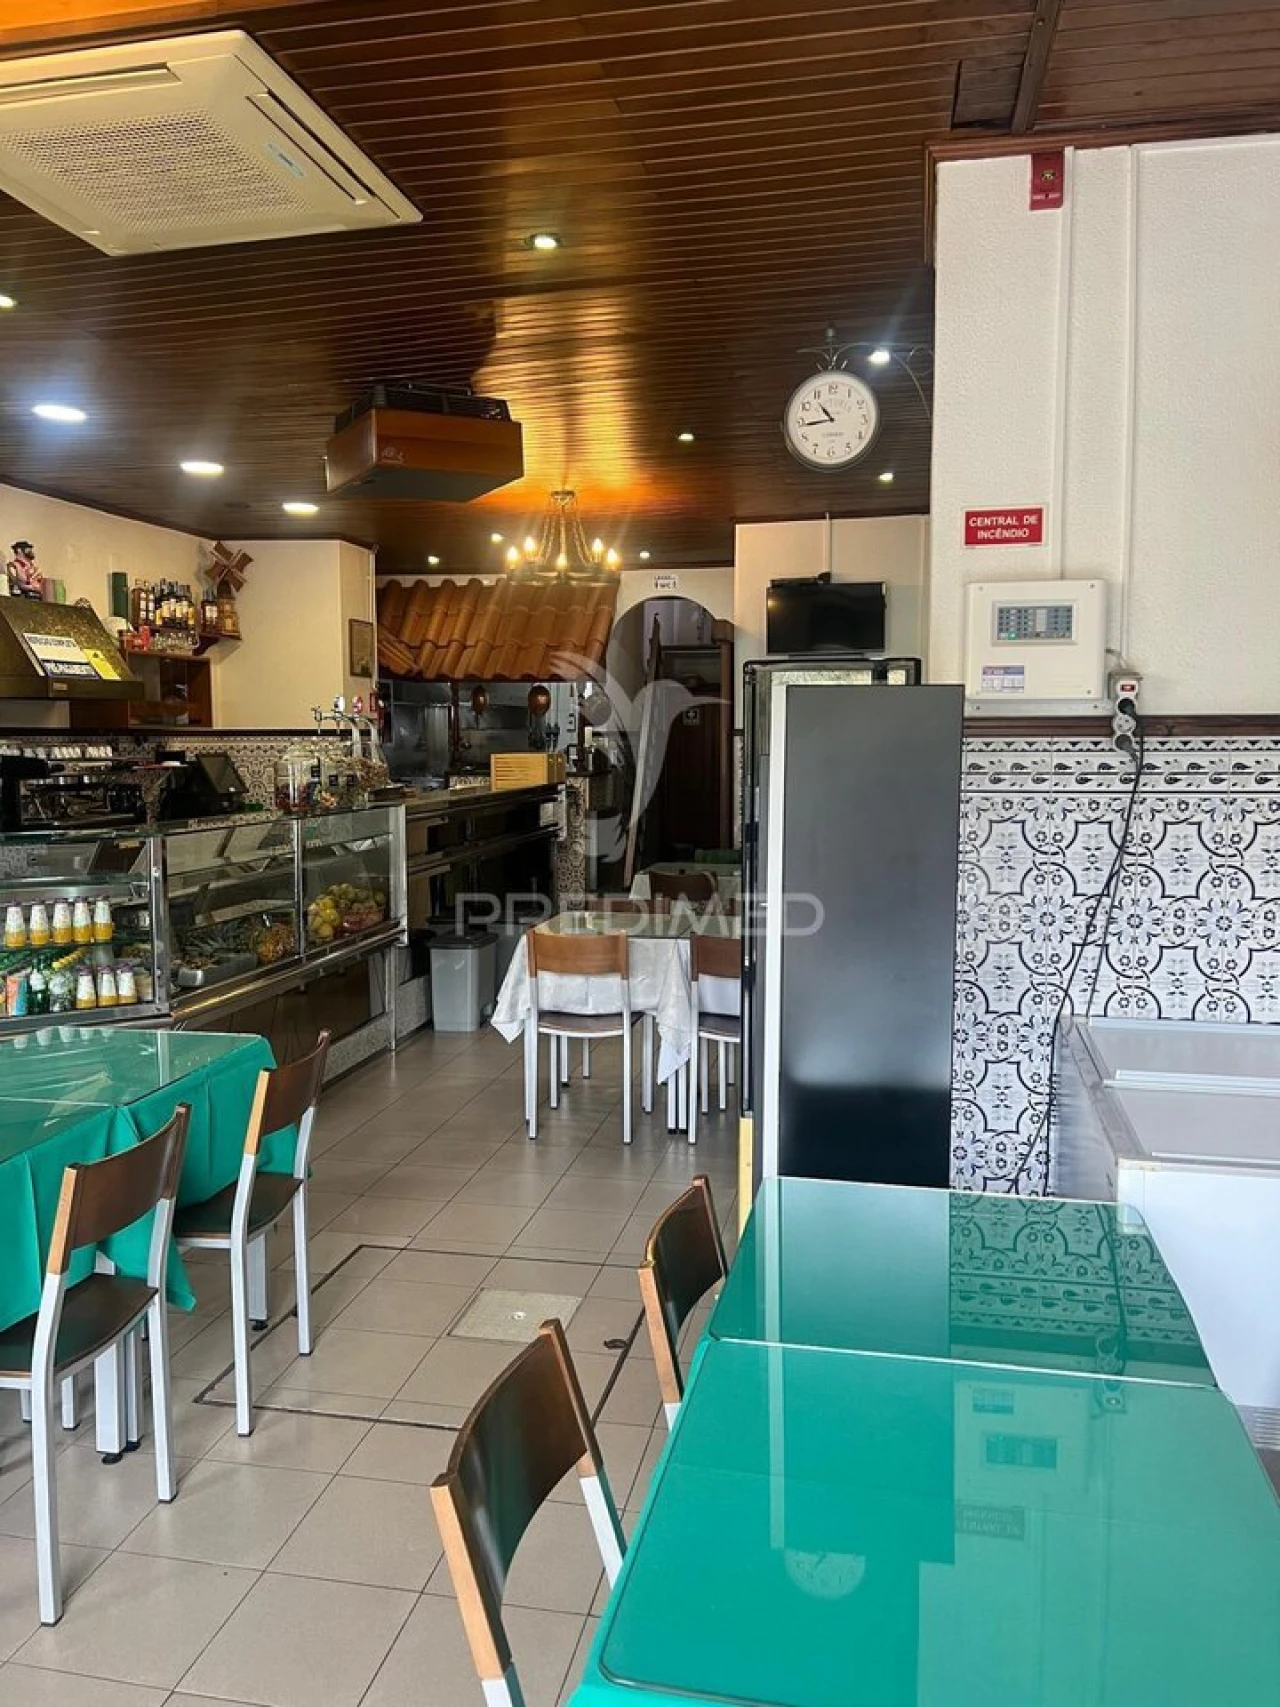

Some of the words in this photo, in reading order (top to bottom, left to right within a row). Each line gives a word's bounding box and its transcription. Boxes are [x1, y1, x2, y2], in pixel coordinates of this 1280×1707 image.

[969, 516, 1019, 527] CENTRAL
[1023, 514, 1039, 525] DE
[977, 528, 1029, 539] INCÊNDIO
